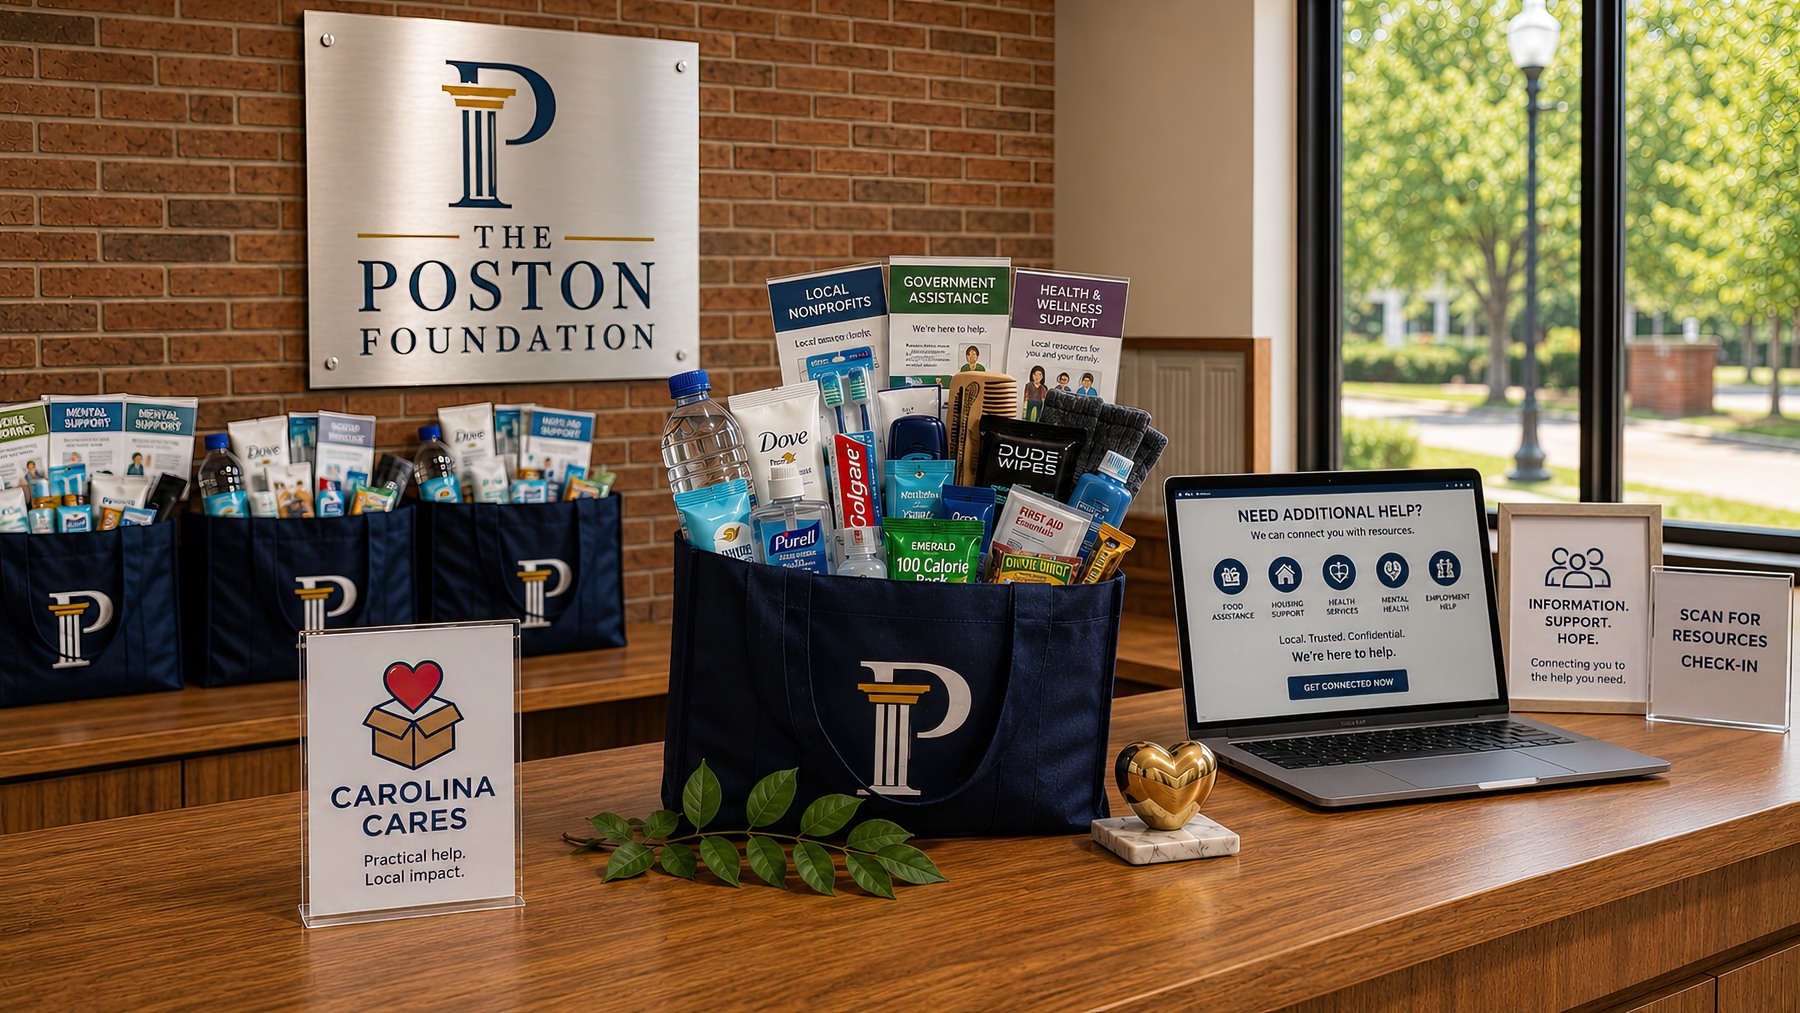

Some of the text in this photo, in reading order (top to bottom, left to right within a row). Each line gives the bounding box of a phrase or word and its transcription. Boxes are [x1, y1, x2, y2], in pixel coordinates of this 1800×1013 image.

[473, 225, 552, 250] THE
[357, 259, 655, 313] POSTON
[903, 276, 996, 290] GOVERNMENT
[805, 283, 850, 301] LOCAL
[908, 292, 990, 305] ASSISTANCE
[1040, 284, 1101, 301] HEALTH &
[788, 295, 872, 320] NONPROFITS
[1036, 298, 1103, 315] WELLNESS
[912, 324, 987, 335] We're here to help.
[1039, 313, 1098, 329] SUPPORT
[359, 323, 655, 356] FOUNDATION
[1031, 339, 1101, 353] Local resources for
[1025, 350, 1041, 359] you
[1042, 351, 1057, 359] and
[758, 430, 808, 453] Dove
[998, 443, 1060, 464] DUDE
[997, 456, 1058, 476] WIPES
[1238, 503, 1423, 523] NEED ADDITIONAL HELP?
[1046, 517, 1064, 531] AID
[774, 529, 816, 552] Purell
[1250, 526, 1416, 540] We can connect you with resources.
[911, 541, 956, 552] EMERALD
[896, 557, 970, 575] 100 Calorie
[1222, 602, 1244, 611] FOOD
[1271, 609, 1305, 618] SUPPORT
[1528, 598, 1630, 612] INFORMATION.
[1545, 615, 1612, 629] SUPPORT.
[1679, 608, 1761, 626] SCAN FOR
[1278, 629, 1406, 645] Local. Trusted. Confidential.
[1557, 633, 1599, 645] HOPE.
[1672, 629, 1768, 648] RESOURCES
[1291, 646, 1397, 662] We're here to help.
[1530, 657, 1625, 672] Connecting you to
[1681, 654, 1758, 673] CHECK-IN
[1303, 678, 1394, 692] GET CONNECTED NOW
[1530, 672, 1626, 685] the help you need.
[330, 775, 496, 809] CAROLINA
[362, 806, 467, 837] CARES
[363, 846, 466, 867] Practical help.
[364, 864, 465, 886] Local impact.
